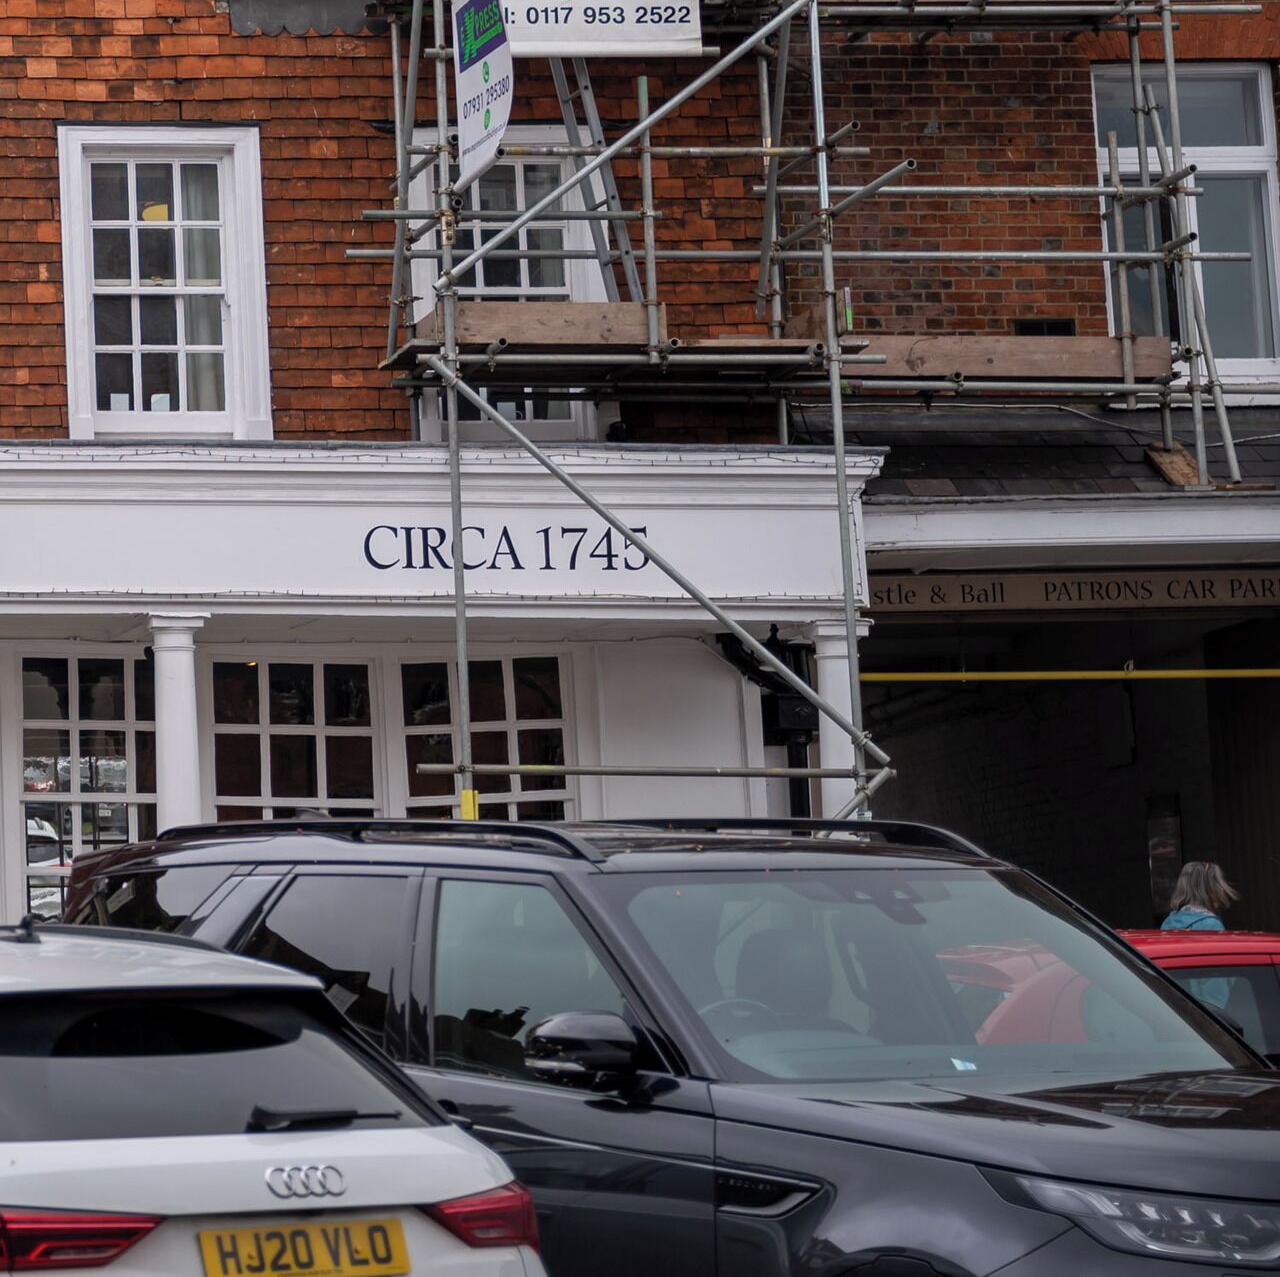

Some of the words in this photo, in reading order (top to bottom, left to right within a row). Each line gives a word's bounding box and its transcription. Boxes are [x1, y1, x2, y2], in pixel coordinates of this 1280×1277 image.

[526, 6, 573, 25] 0117
[583, 6, 626, 25] 953
[634, 6, 692, 24] 2522
[463, 92, 484, 119] 07931
[485, 75, 510, 106] 295380
[363, 525, 525, 570] CIRCA
[536, 525, 650, 570] 1745
[873, 583, 917, 605] stle
[929, 584, 946, 604] &
[960, 582, 1006, 604] Ball
[1043, 580, 1153, 601] PATRONS
[1166, 579, 1216, 600] CAR
[1228, 578, 1280, 599] PAR
[216, 1229, 315, 1276] HJ20
